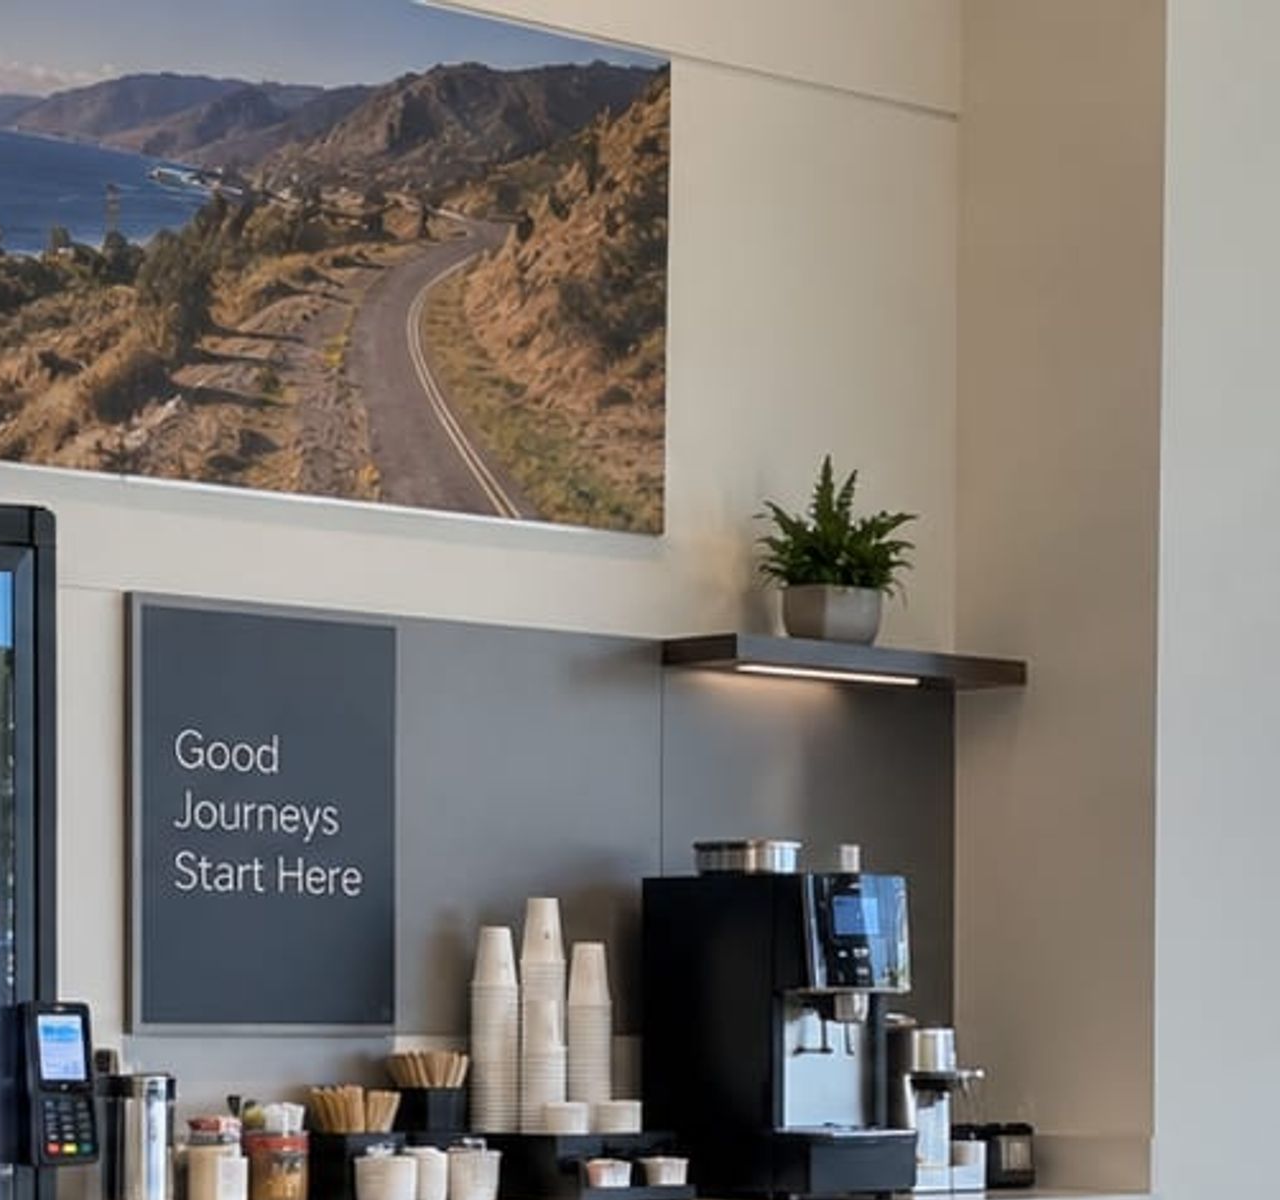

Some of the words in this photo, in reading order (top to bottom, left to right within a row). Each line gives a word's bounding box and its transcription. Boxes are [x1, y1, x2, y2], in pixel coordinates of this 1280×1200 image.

[174, 728, 280, 774] Good
[173, 790, 341, 843] Journeys
[174, 850, 265, 894] Start
[278, 855, 363, 896] Here
